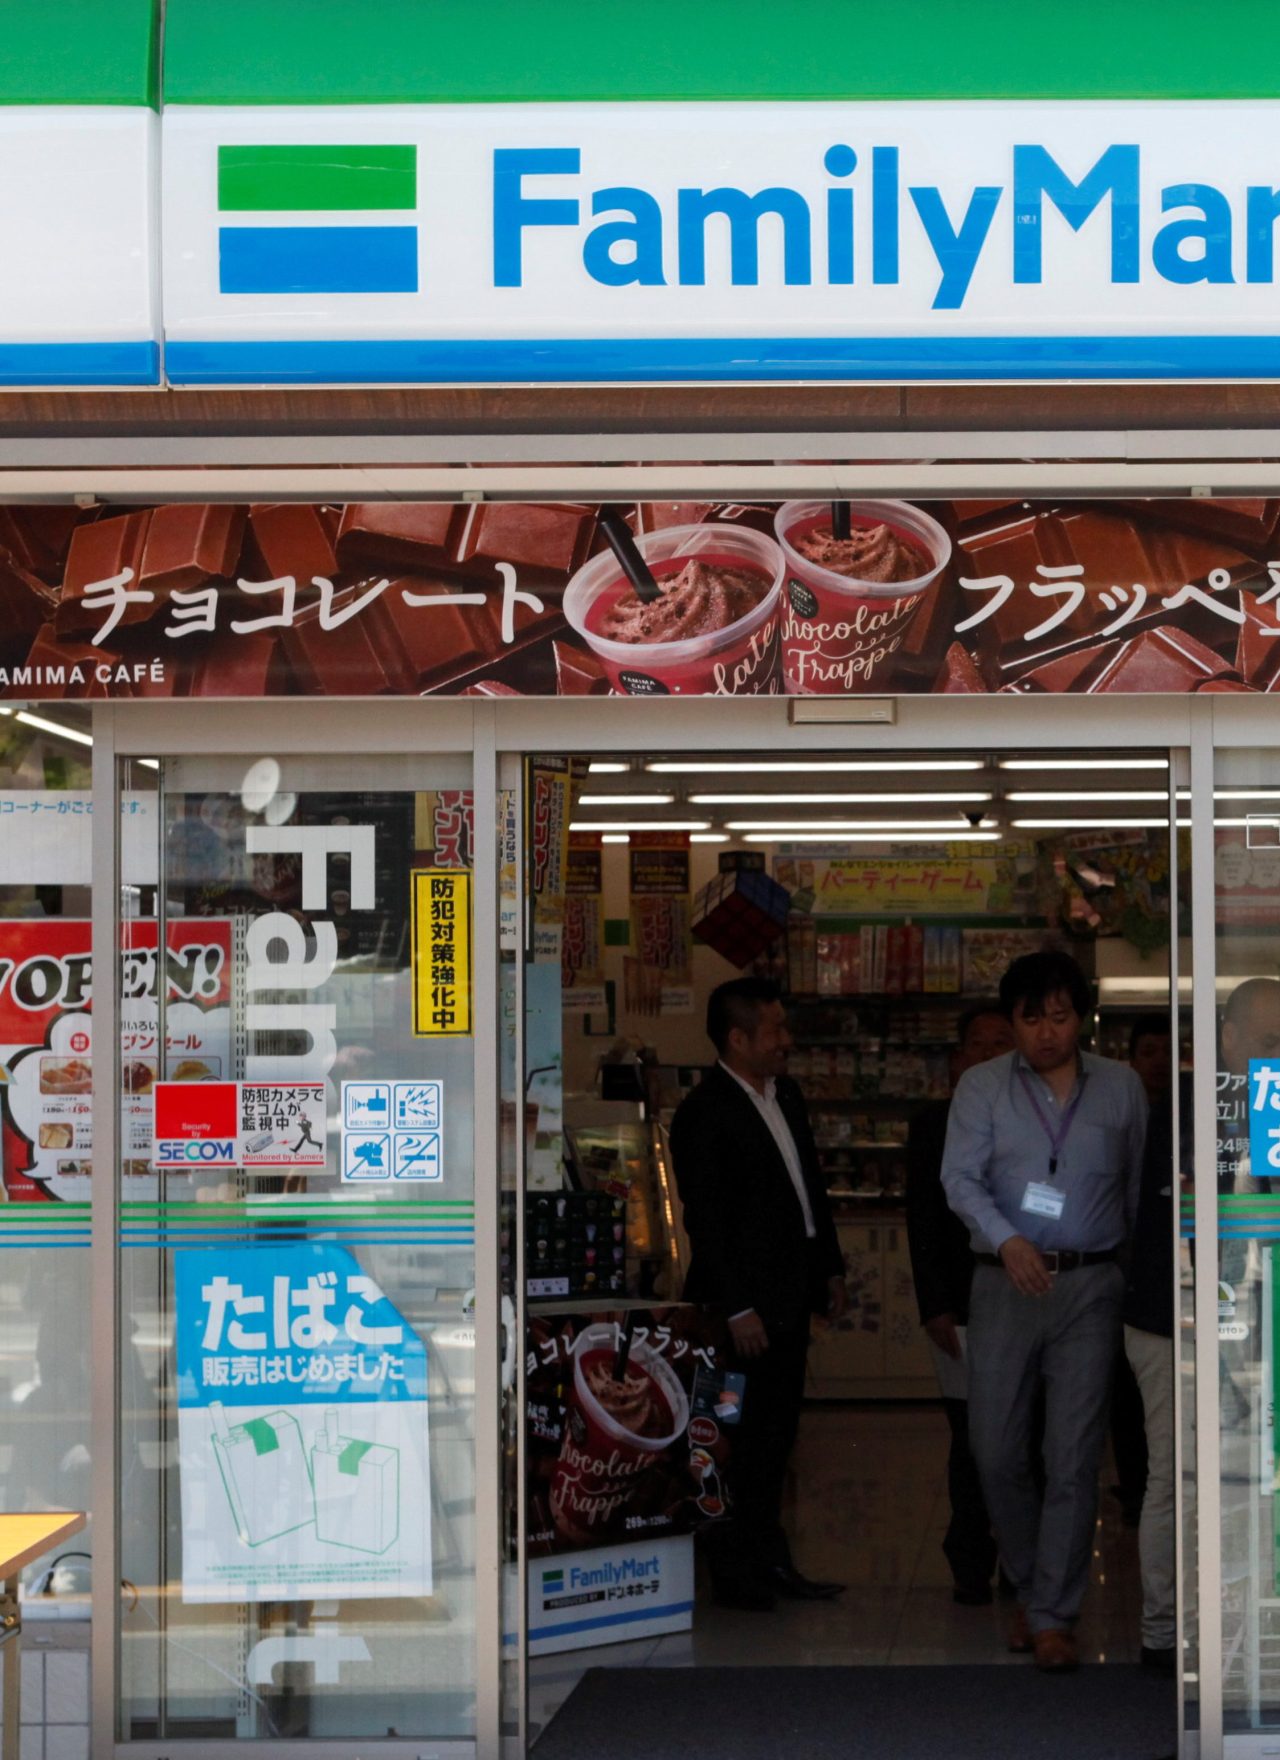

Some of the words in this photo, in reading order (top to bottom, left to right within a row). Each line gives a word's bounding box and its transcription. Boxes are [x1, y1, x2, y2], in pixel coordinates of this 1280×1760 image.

[81, 561, 545, 645] チョコレート
[95, 657, 164, 683] CAFÉ
[431, 878, 455, 1030] 防犯対策強化中
[242, 1088, 324, 1103] 防犯カメラで
[242, 1102, 301, 1117] セコムが
[181, 1122, 212, 1132] Security
[242, 1116, 290, 1131] 監視中
[159, 1141, 234, 1161] SECOM
[241, 1153, 281, 1162] Monitored
[283, 1153, 293, 1164] by
[294, 1153, 324, 1162] Camera
[202, 1271, 404, 1353] たばこ
[202, 1352, 405, 1387] 販売はじめました
[569, 1555, 661, 1589] FamilyMart
